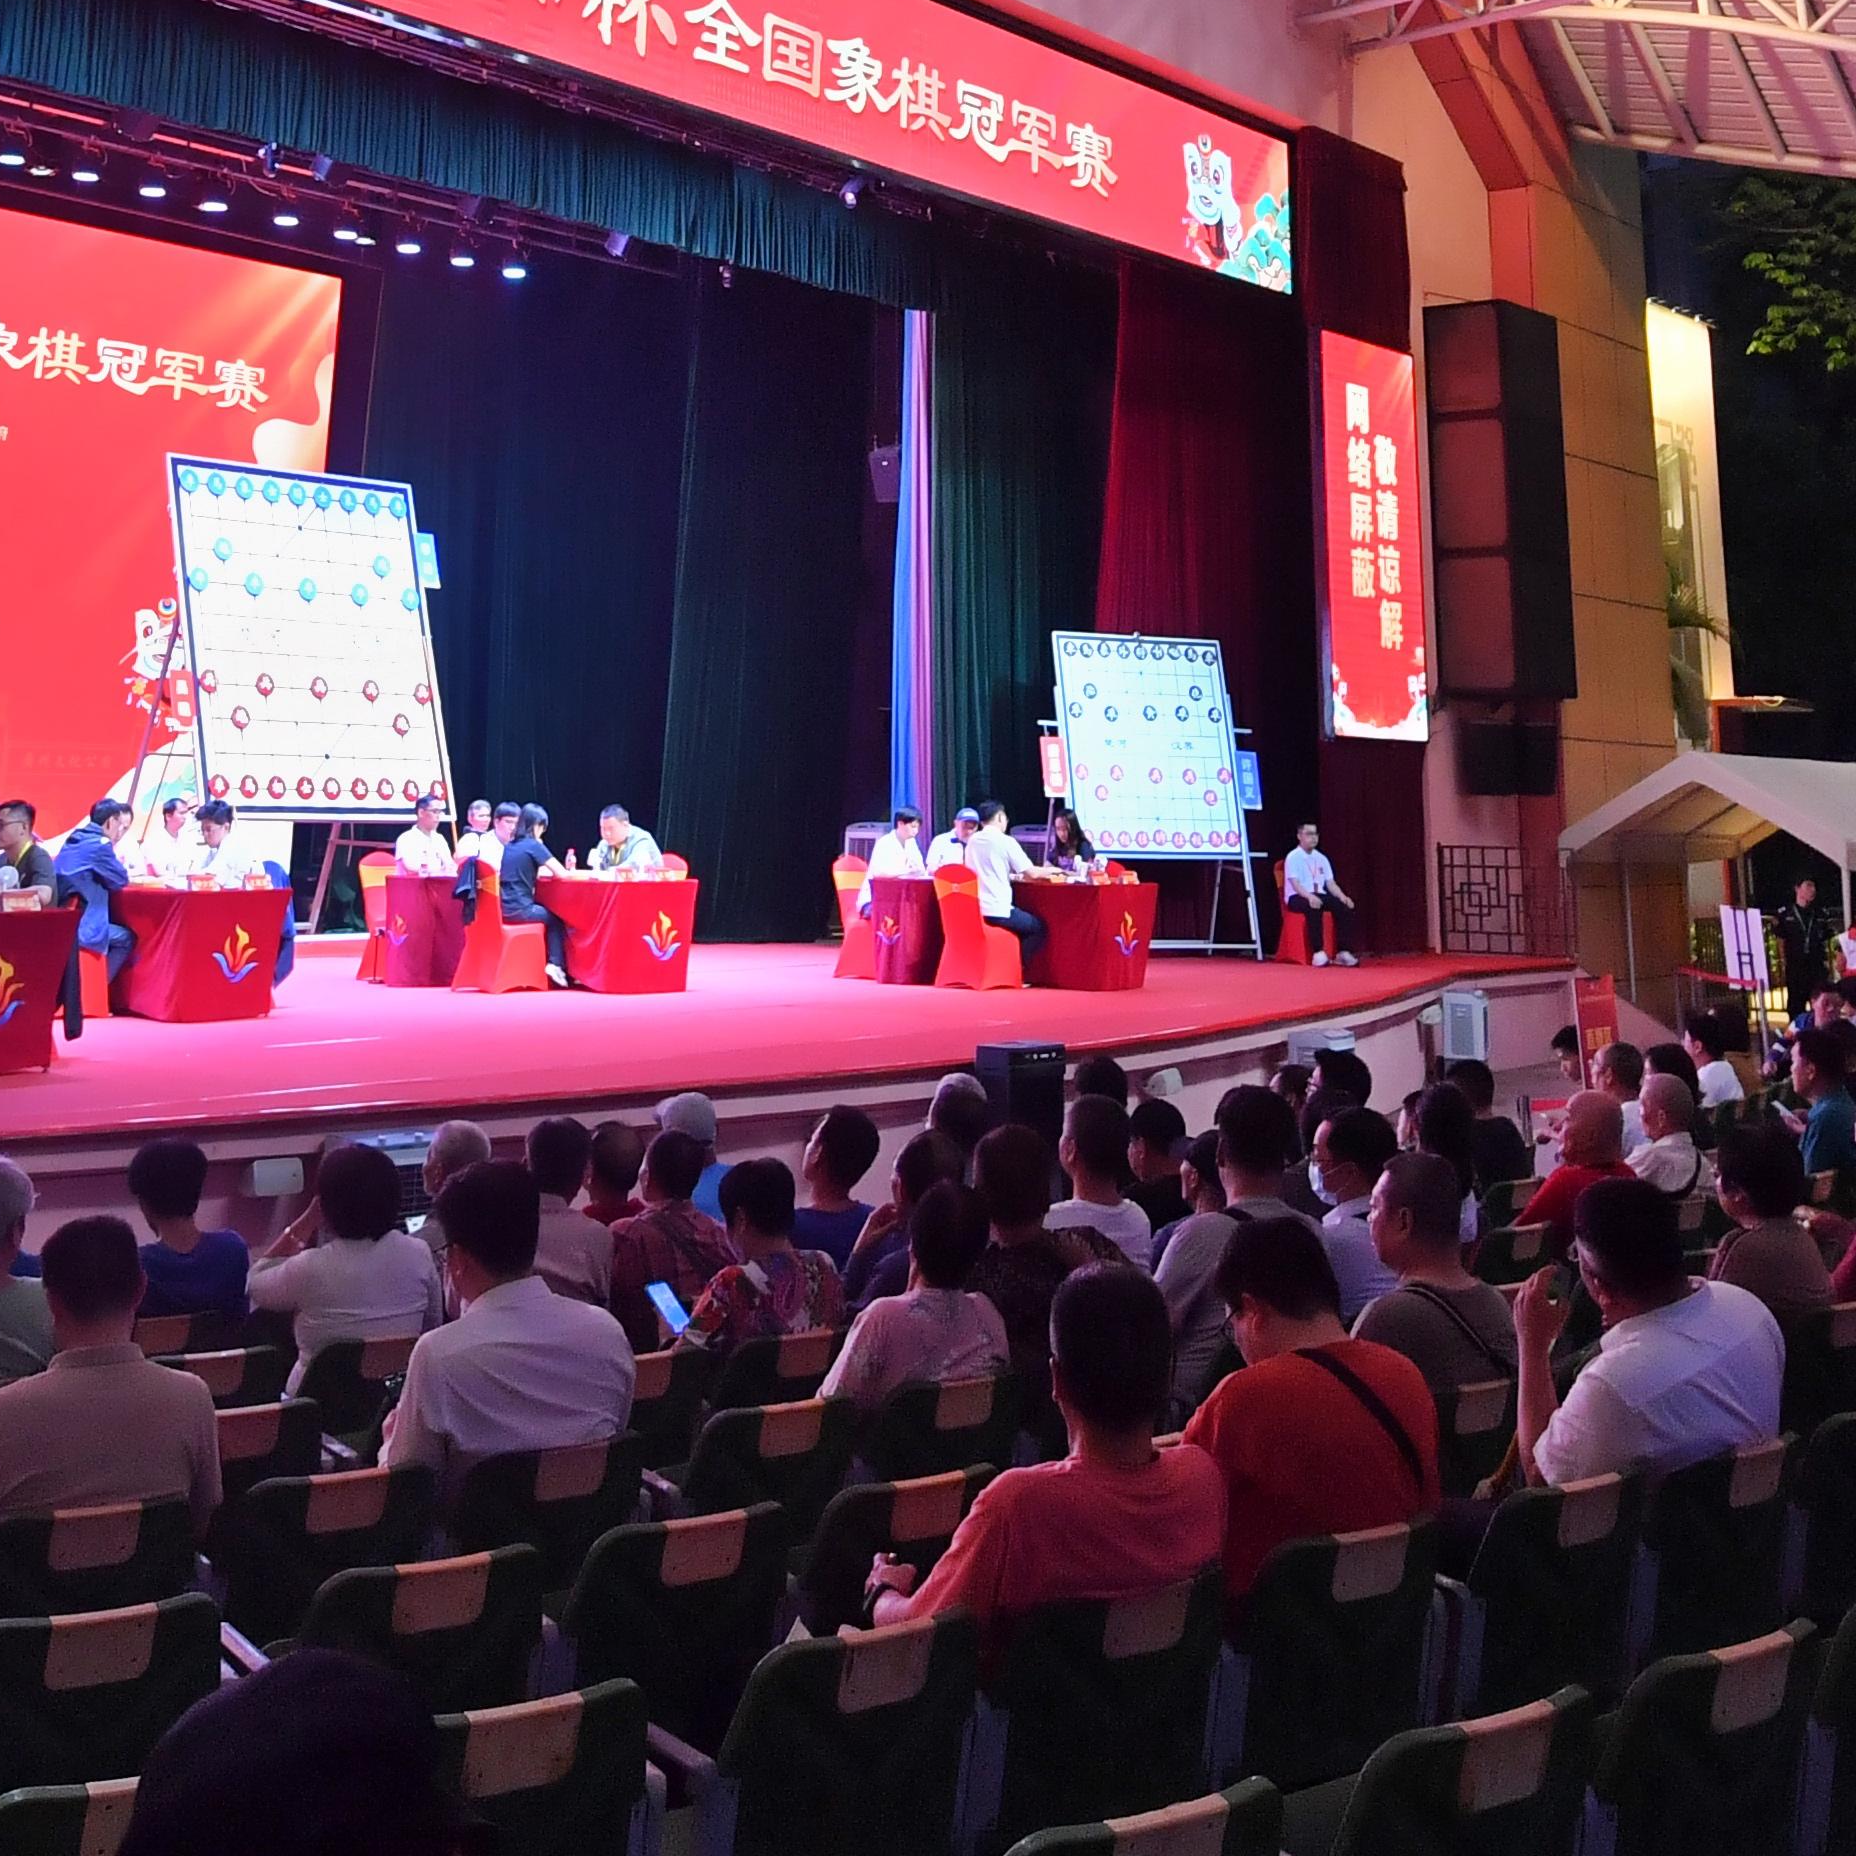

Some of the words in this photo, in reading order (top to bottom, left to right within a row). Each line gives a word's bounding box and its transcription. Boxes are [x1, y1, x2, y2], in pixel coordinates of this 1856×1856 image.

[1345, 382, 1376, 599] 网络屏蔽
[1373, 433, 1404, 651] 敬请谅解
